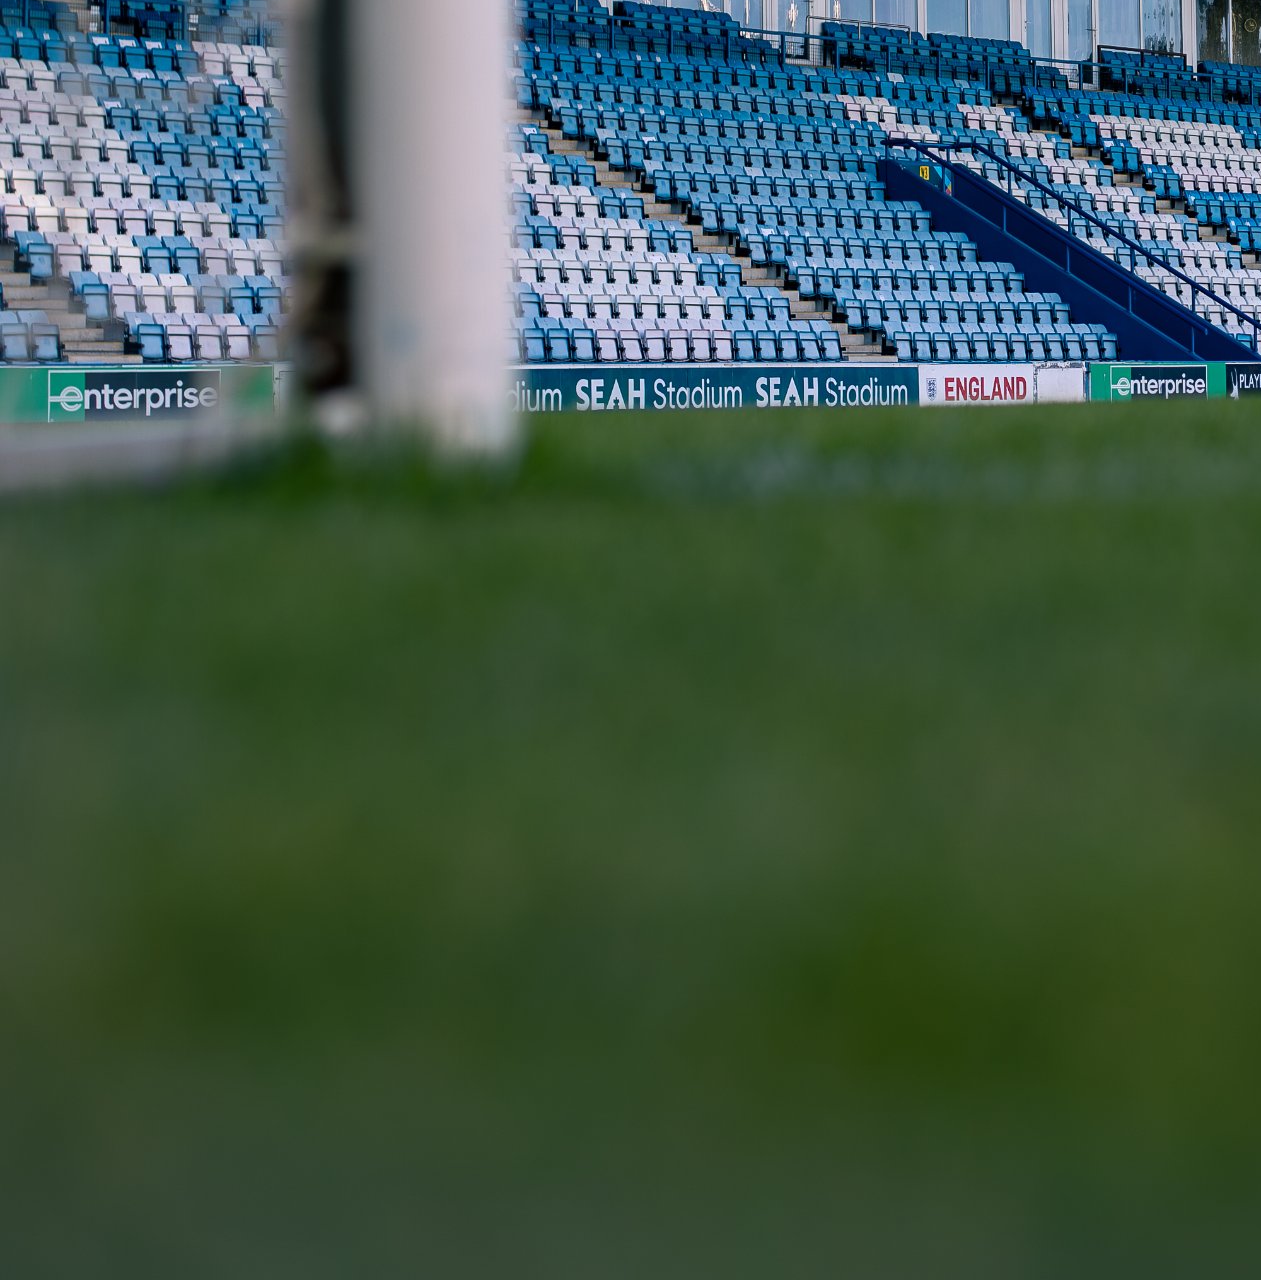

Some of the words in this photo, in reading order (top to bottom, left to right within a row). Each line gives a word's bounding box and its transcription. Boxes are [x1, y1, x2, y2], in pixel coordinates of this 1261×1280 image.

[59, 380, 219, 416] enterprise
[506, 380, 562, 411] dium
[575, 378, 645, 411] SEAH
[653, 378, 743, 409] Stadium
[755, 376, 819, 408] SEAH
[825, 377, 908, 407] Stadium
[944, 376, 1027, 402] ENGLAND
[1116, 373, 1206, 399] enterprise
